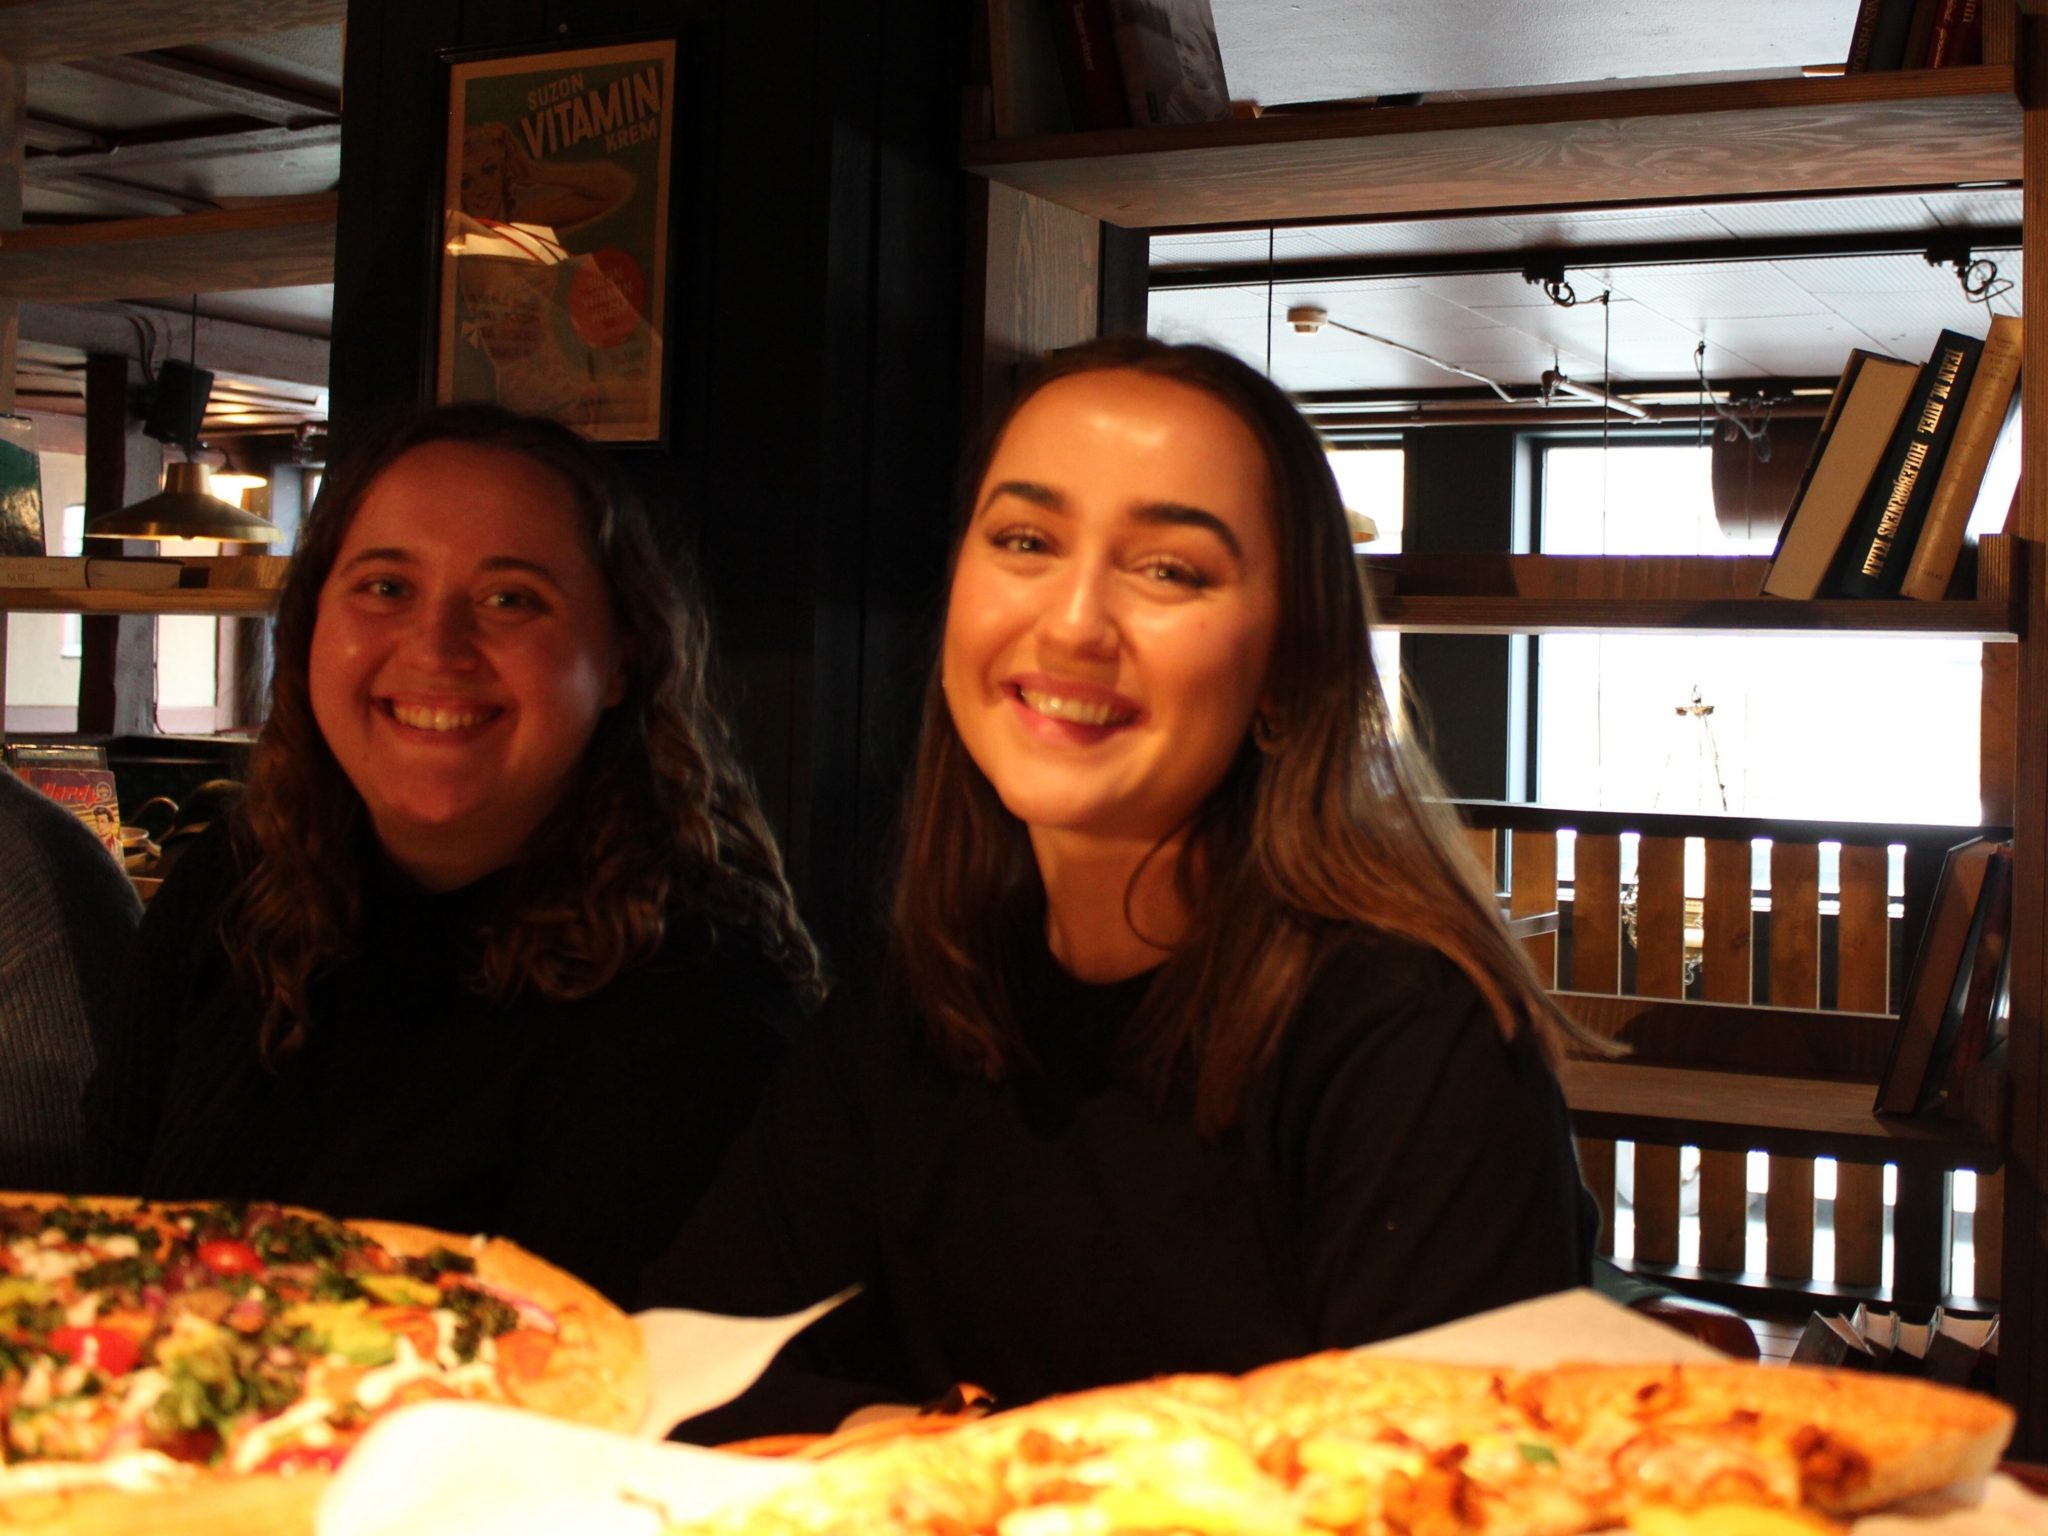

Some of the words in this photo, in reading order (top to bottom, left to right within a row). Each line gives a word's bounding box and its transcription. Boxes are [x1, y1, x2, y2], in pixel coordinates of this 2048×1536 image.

[527, 71, 584, 111] SUZON
[519, 66, 661, 160] VITAMIN
[605, 119, 658, 154] KREM
[1937, 347, 1964, 384] JEAN
[1930, 382, 1951, 400] M.
[1916, 399, 1944, 434] AUEL
[1877, 440, 1929, 539] HULEBJØRNENS
[1862, 538, 1892, 579] KLAN
[41, 782, 99, 809] Hardy
